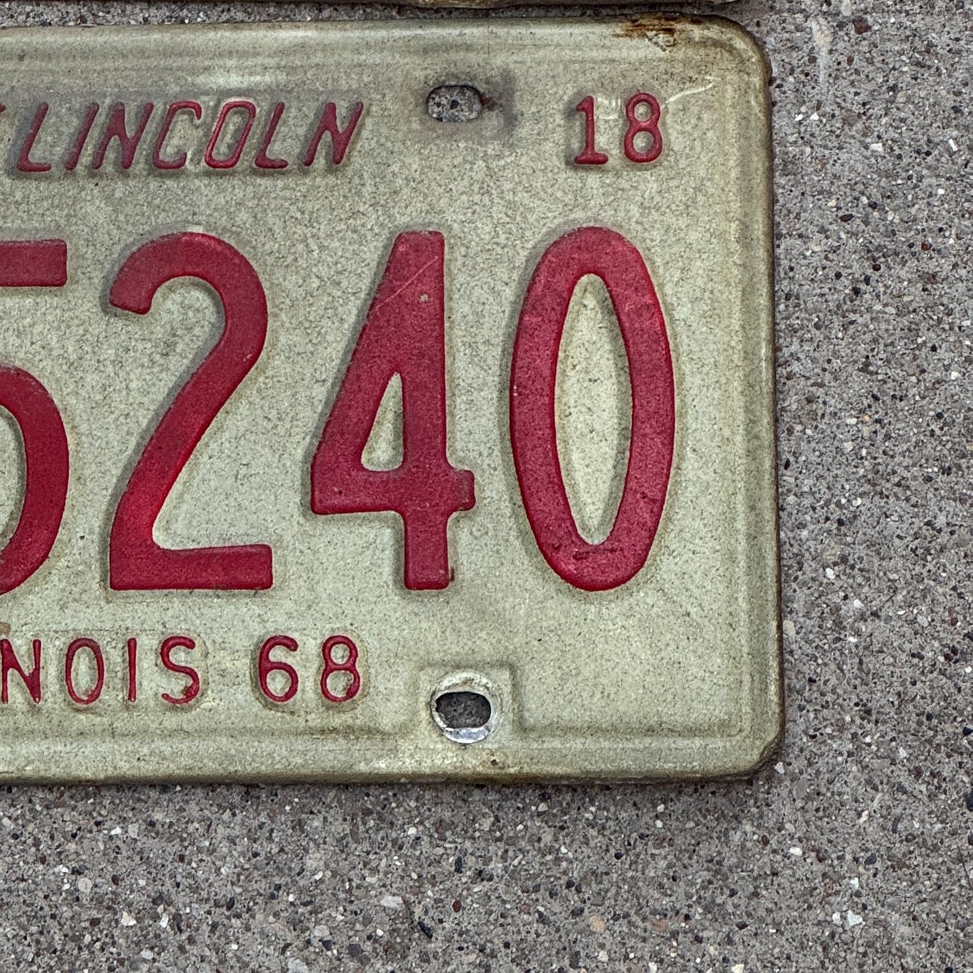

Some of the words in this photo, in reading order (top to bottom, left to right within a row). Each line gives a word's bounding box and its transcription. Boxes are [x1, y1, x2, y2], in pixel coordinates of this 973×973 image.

[12, 97, 365, 173] LINCOLN
[568, 91, 664, 167] 18
[257, 633, 362, 706] 68
